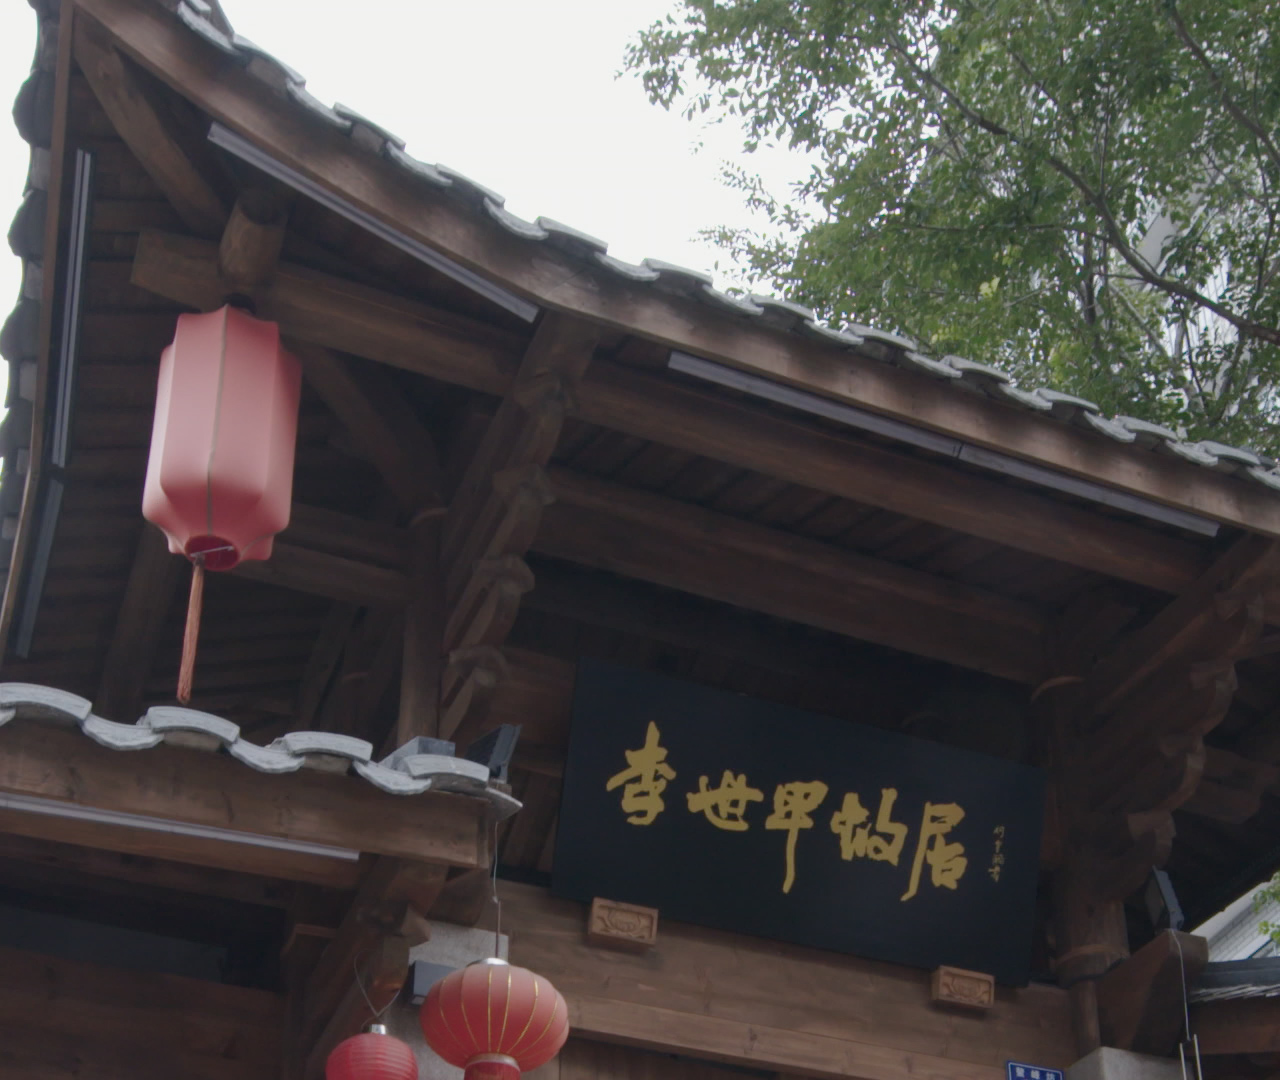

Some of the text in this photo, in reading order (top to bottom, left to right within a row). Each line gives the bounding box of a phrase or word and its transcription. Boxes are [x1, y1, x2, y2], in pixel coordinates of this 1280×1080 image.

[607, 721, 968, 901] 李世甲故居
